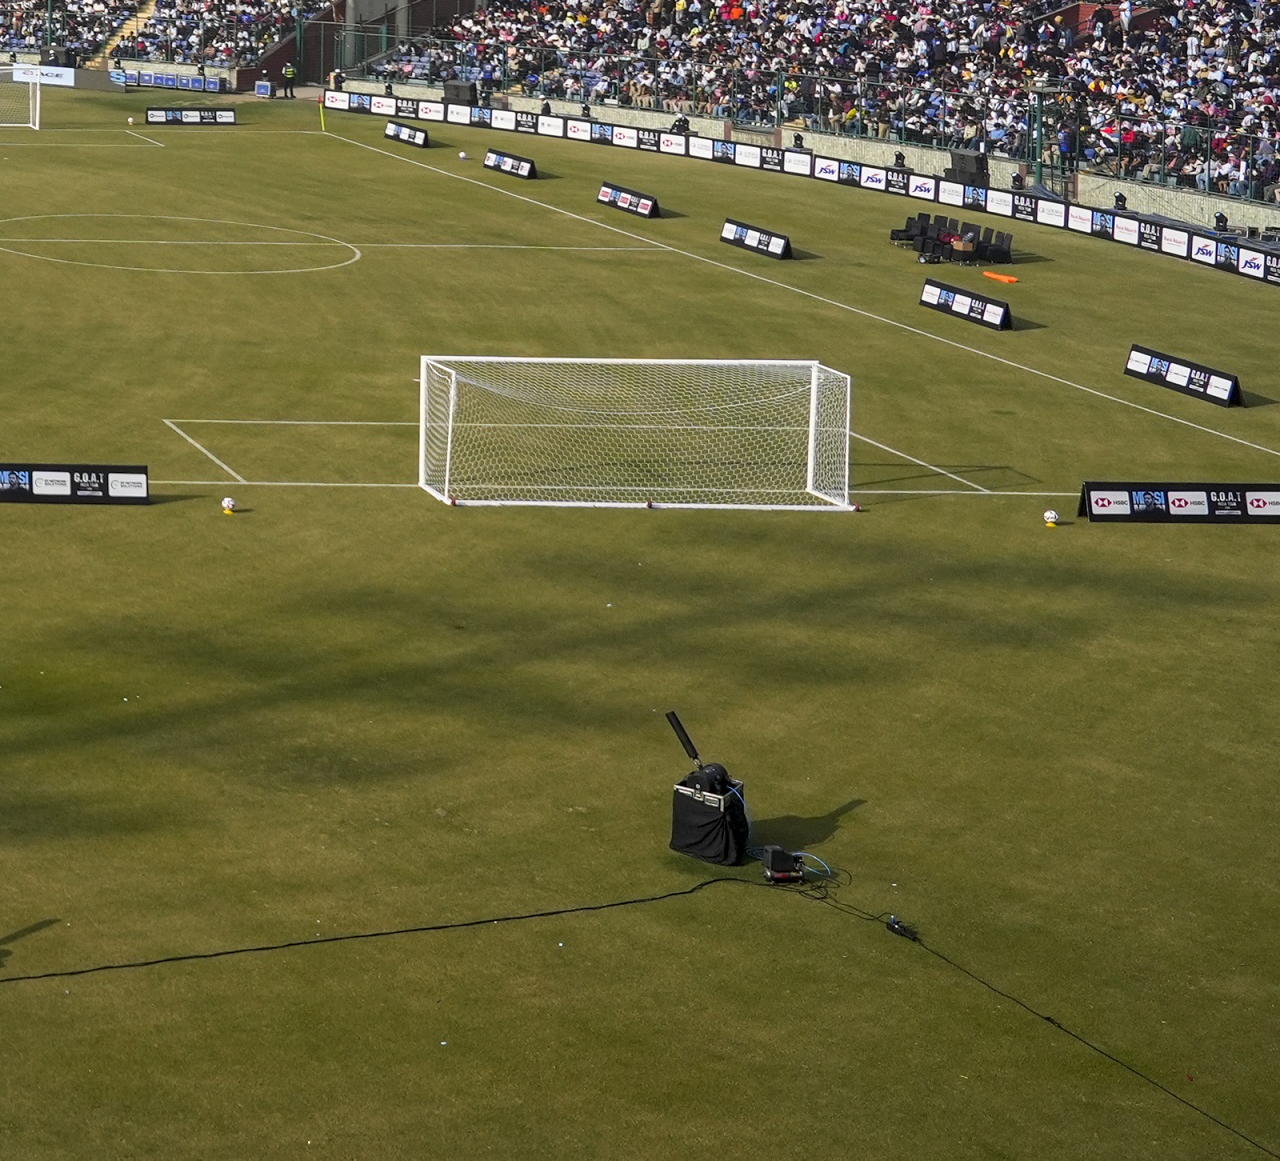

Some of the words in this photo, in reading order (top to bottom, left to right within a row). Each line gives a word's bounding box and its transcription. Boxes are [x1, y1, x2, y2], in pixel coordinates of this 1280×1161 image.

[818, 166, 836, 176] JSW
[864, 175, 884, 185] JSW
[912, 185, 932, 194] JSW
[1194, 246, 1213, 257] JSW
[1241, 259, 1262, 270] JSW
[1210, 491, 1241, 502] G.O.A.T
